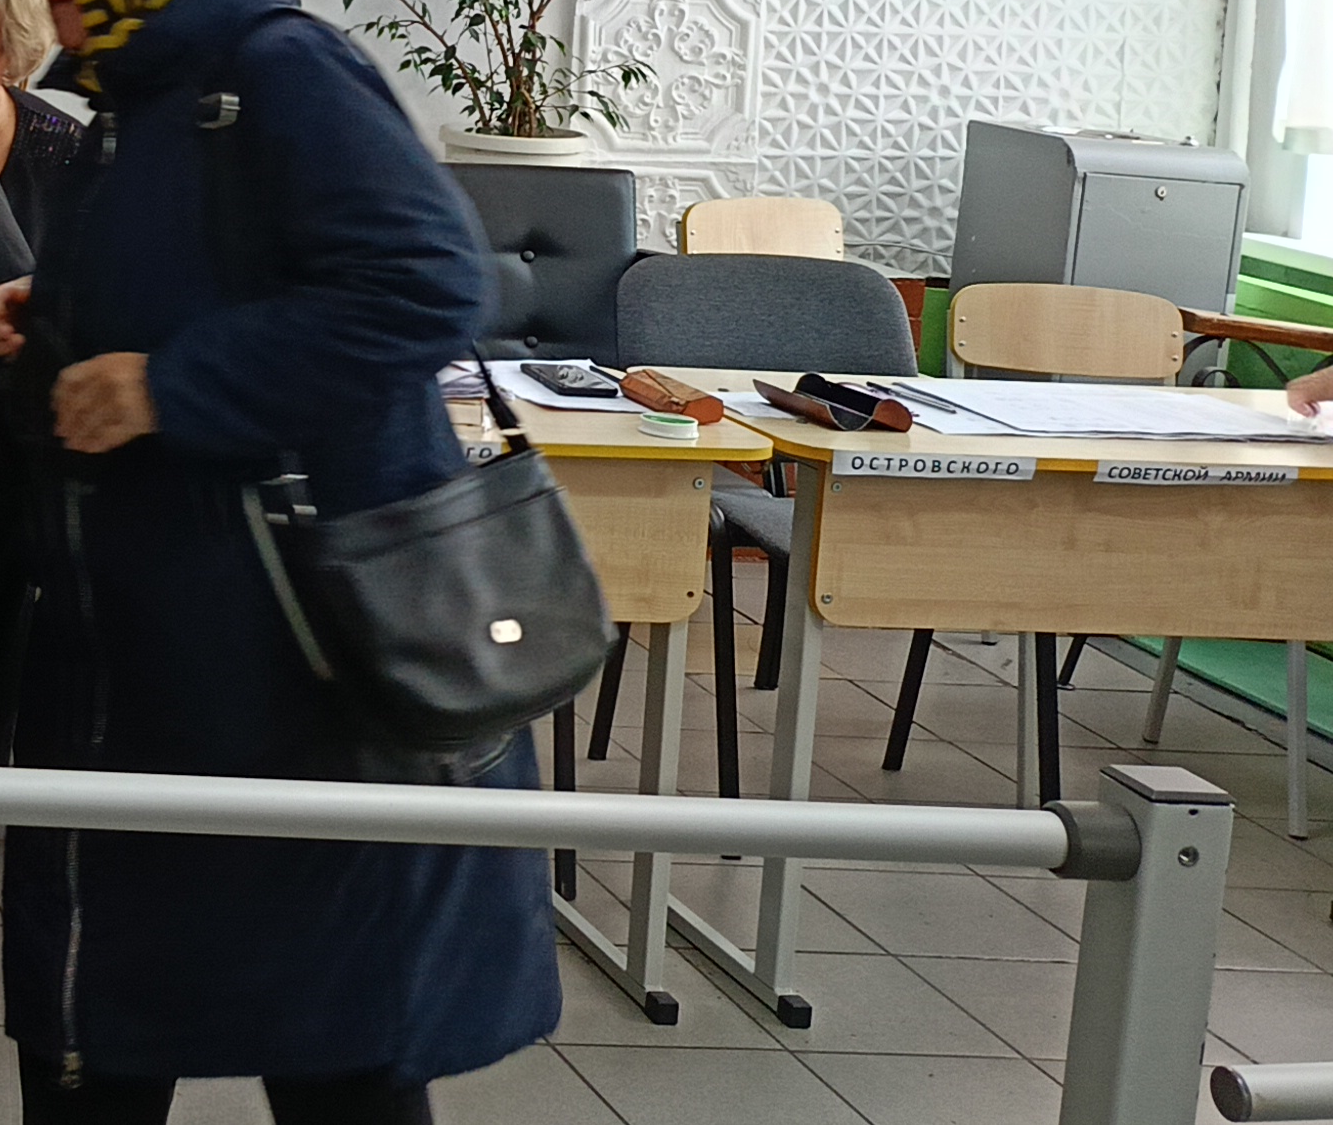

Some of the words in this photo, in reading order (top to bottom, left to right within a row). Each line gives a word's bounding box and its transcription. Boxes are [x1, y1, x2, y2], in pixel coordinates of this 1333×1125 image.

[851, 456, 1019, 475] ОСТРОВСКОГО
[1107, 465, 1209, 481] СОВЕТСКОЙ
[1219, 470, 1287, 483] АРМИИ
